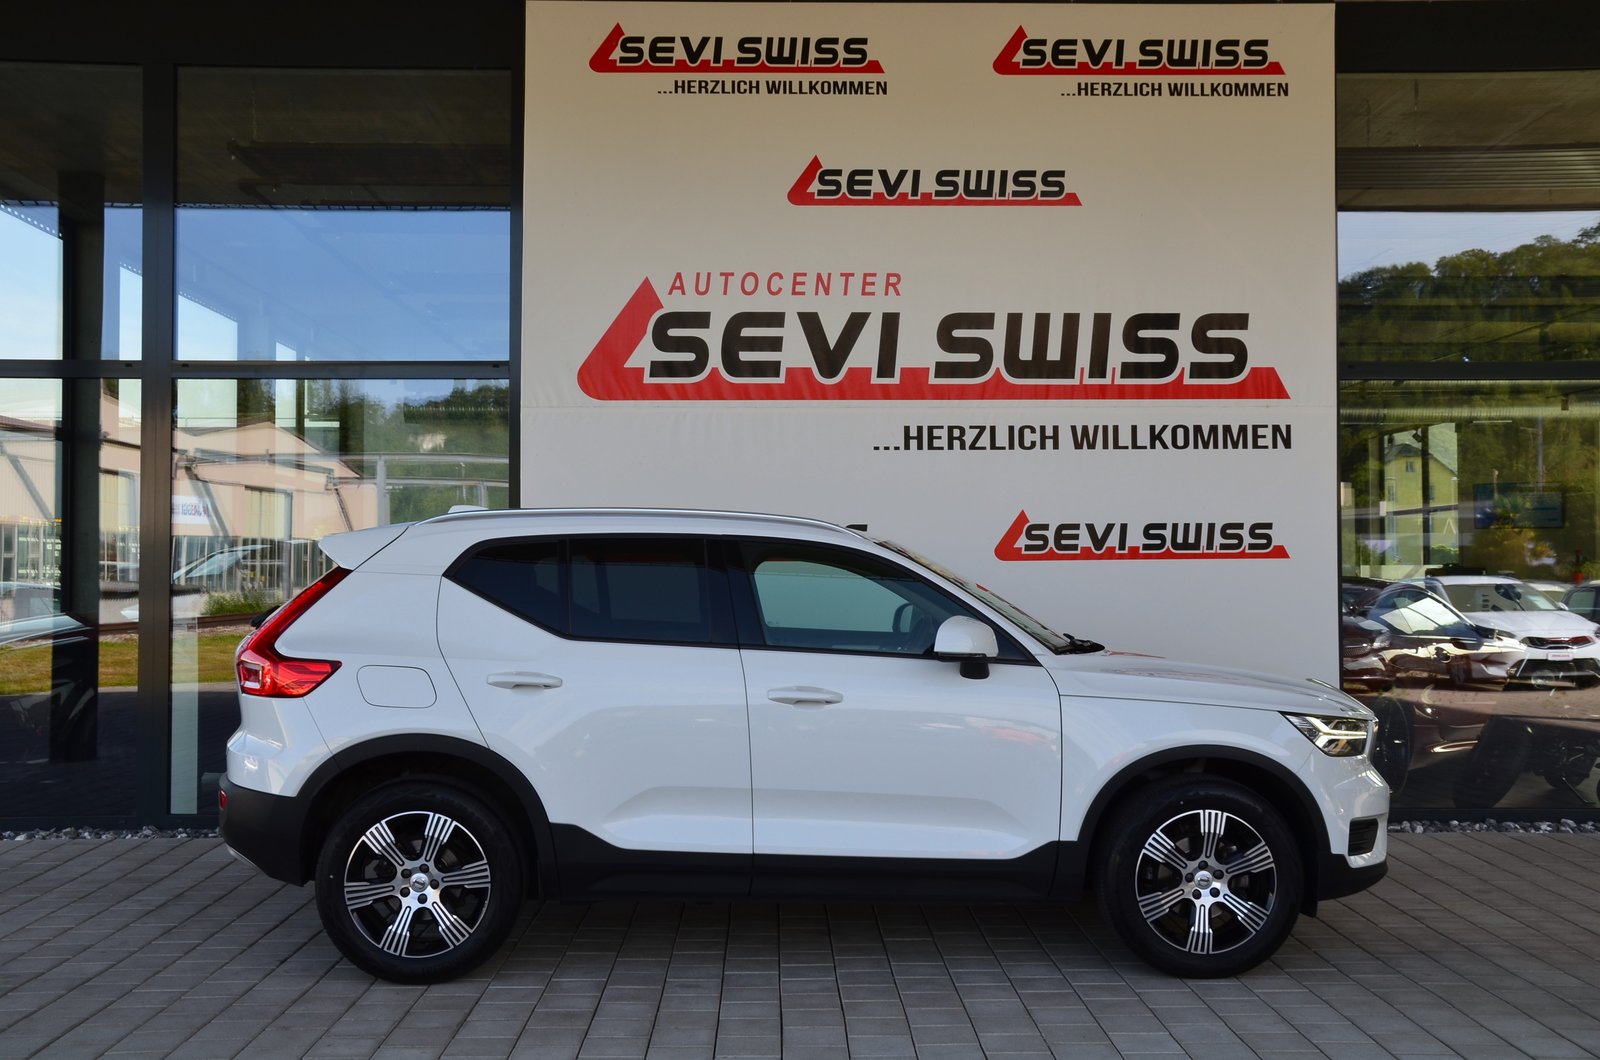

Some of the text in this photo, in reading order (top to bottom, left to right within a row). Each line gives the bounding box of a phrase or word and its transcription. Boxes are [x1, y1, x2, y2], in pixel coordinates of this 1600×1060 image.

[618, 36, 869, 66] SEVI SWISS
[1021, 38, 1269, 68] SEVI SWISS
[657, 79, 888, 95] ...HERZLICH WILLKOMMEN
[1061, 82, 1289, 97] ...HERZLICH WILLKOMMEN
[816, 168, 1066, 198] SEVI SWISS
[667, 271, 902, 297] AUTOCENTER
[649, 311, 1250, 380] SEVI SWISS
[873, 424, 1292, 451] ...HERZLICH WILLKOMMEN
[1024, 522, 1273, 552] SEVI SWISS
